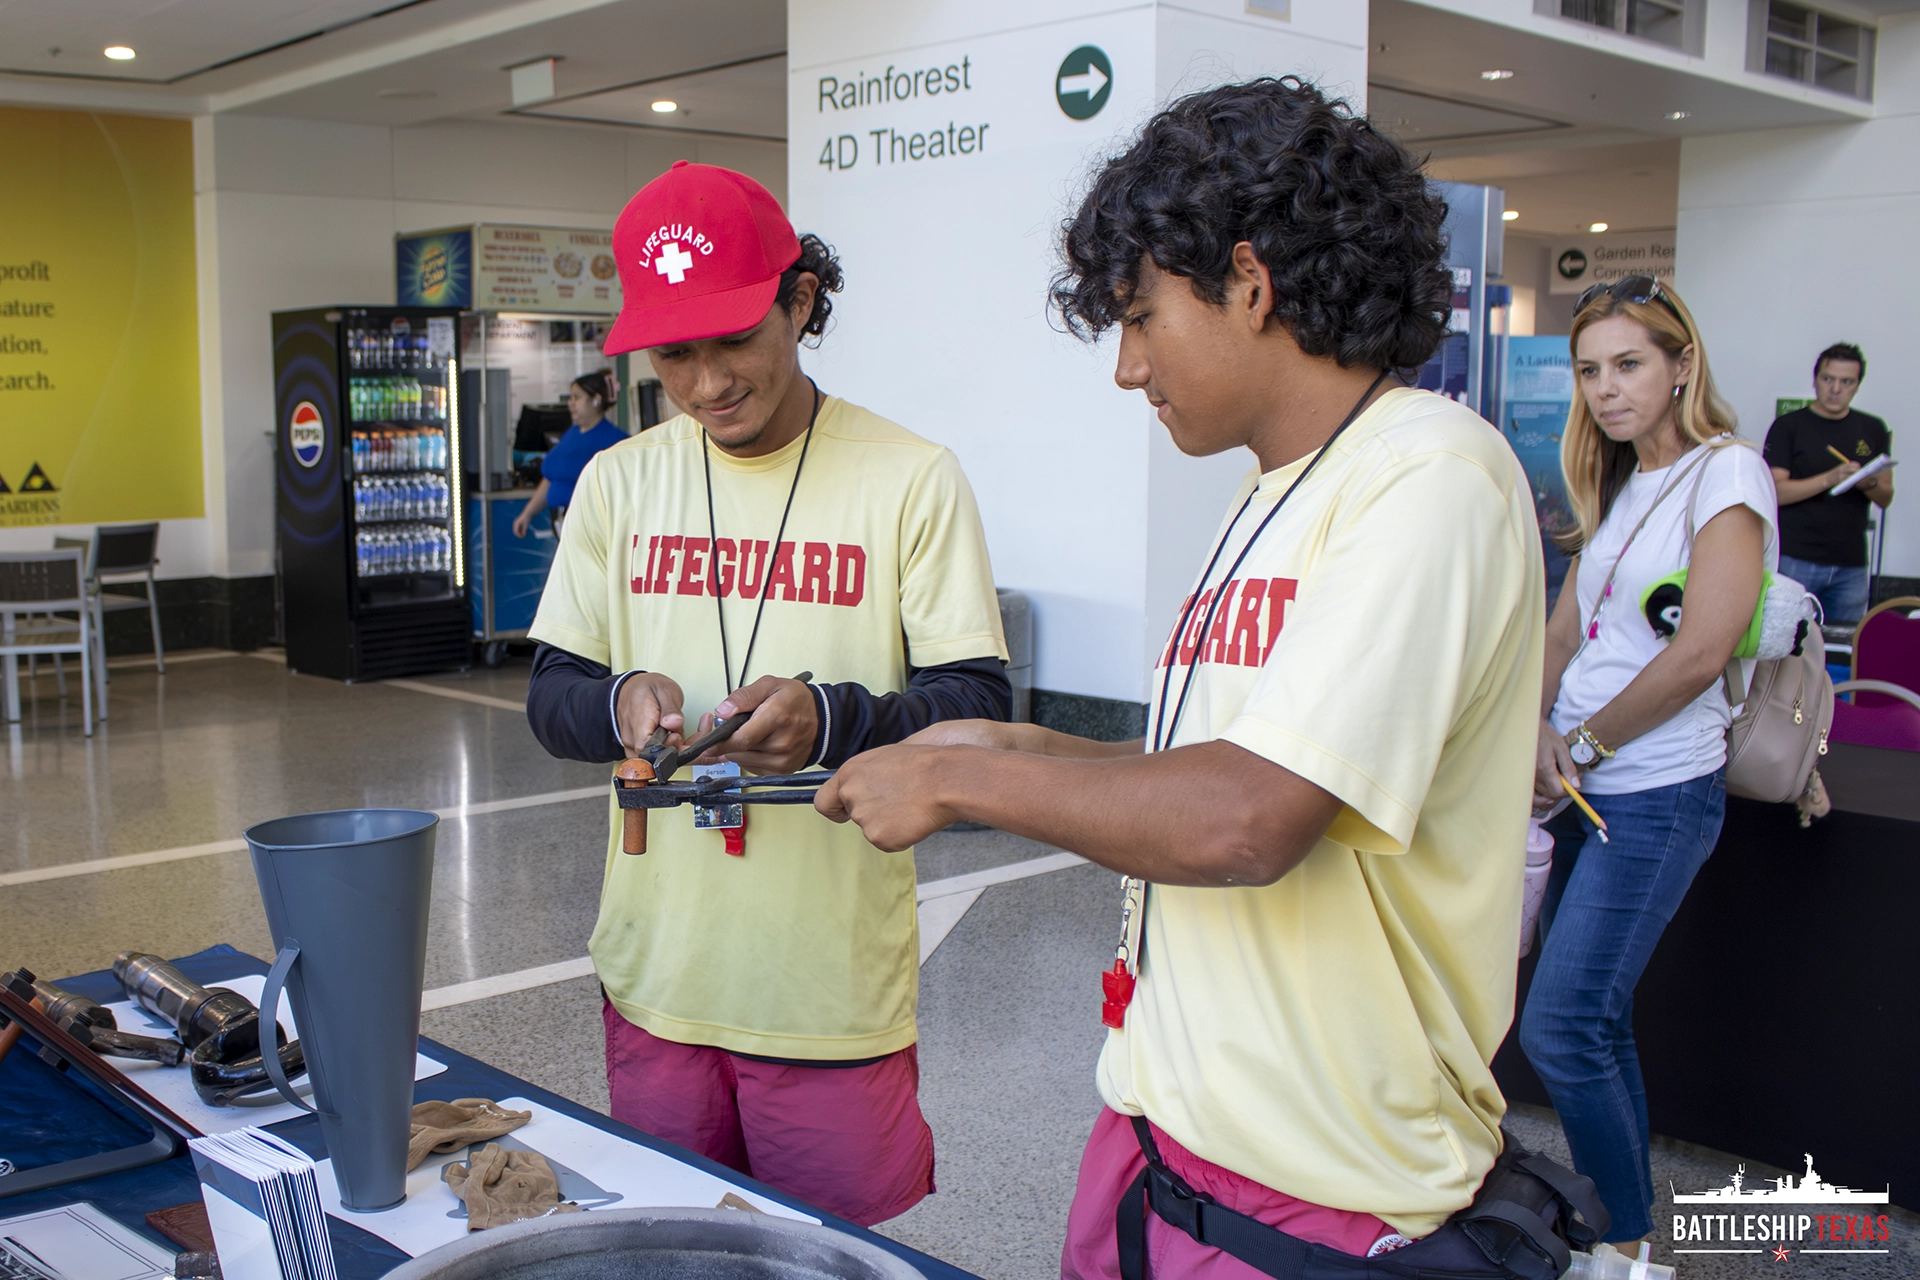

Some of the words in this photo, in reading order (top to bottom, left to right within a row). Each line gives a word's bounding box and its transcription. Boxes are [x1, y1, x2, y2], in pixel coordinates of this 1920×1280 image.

[818, 54, 971, 113] Rainforest
[818, 133, 859, 172] 4D
[869, 121, 990, 165] Theater
[638, 223, 714, 268] LIFEGUARD
[1594, 246, 1646, 260] Garden
[0, 299, 55, 318] ature
[1515, 355, 1524, 367] A
[294, 427, 320, 441] PEPSI
